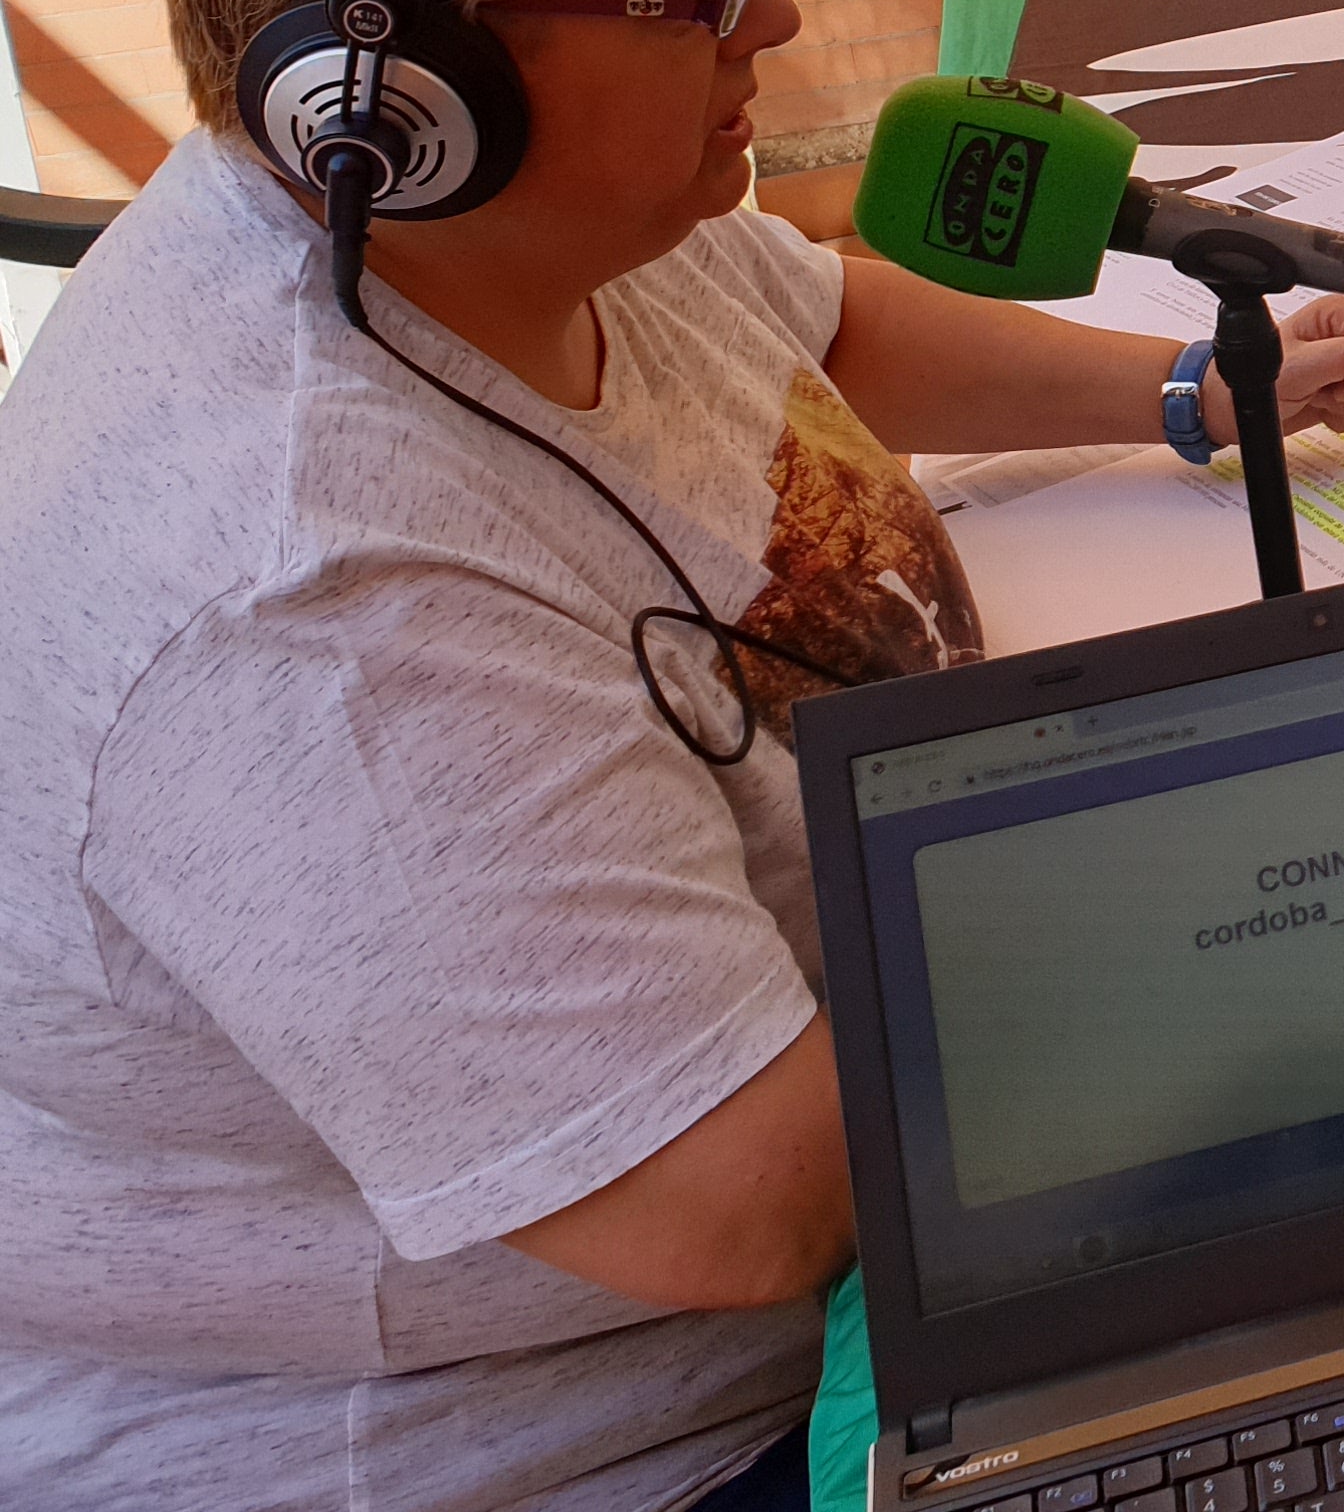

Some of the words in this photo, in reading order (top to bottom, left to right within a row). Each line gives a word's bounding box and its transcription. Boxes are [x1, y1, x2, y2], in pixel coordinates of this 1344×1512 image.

[353, 8, 364, 19] K
[366, 11, 384, 23] 141
[946, 148, 986, 235] ONDA
[984, 154, 1025, 242] CERO
[1304, 1412, 1319, 1425] F6
[1240, 1430, 1256, 1444] F5
[1175, 1448, 1191, 1460] F4
[1110, 1468, 1127, 1480] F3
[1274, 1478, 1285, 1494] 5
[1046, 1488, 1063, 1500] F2
